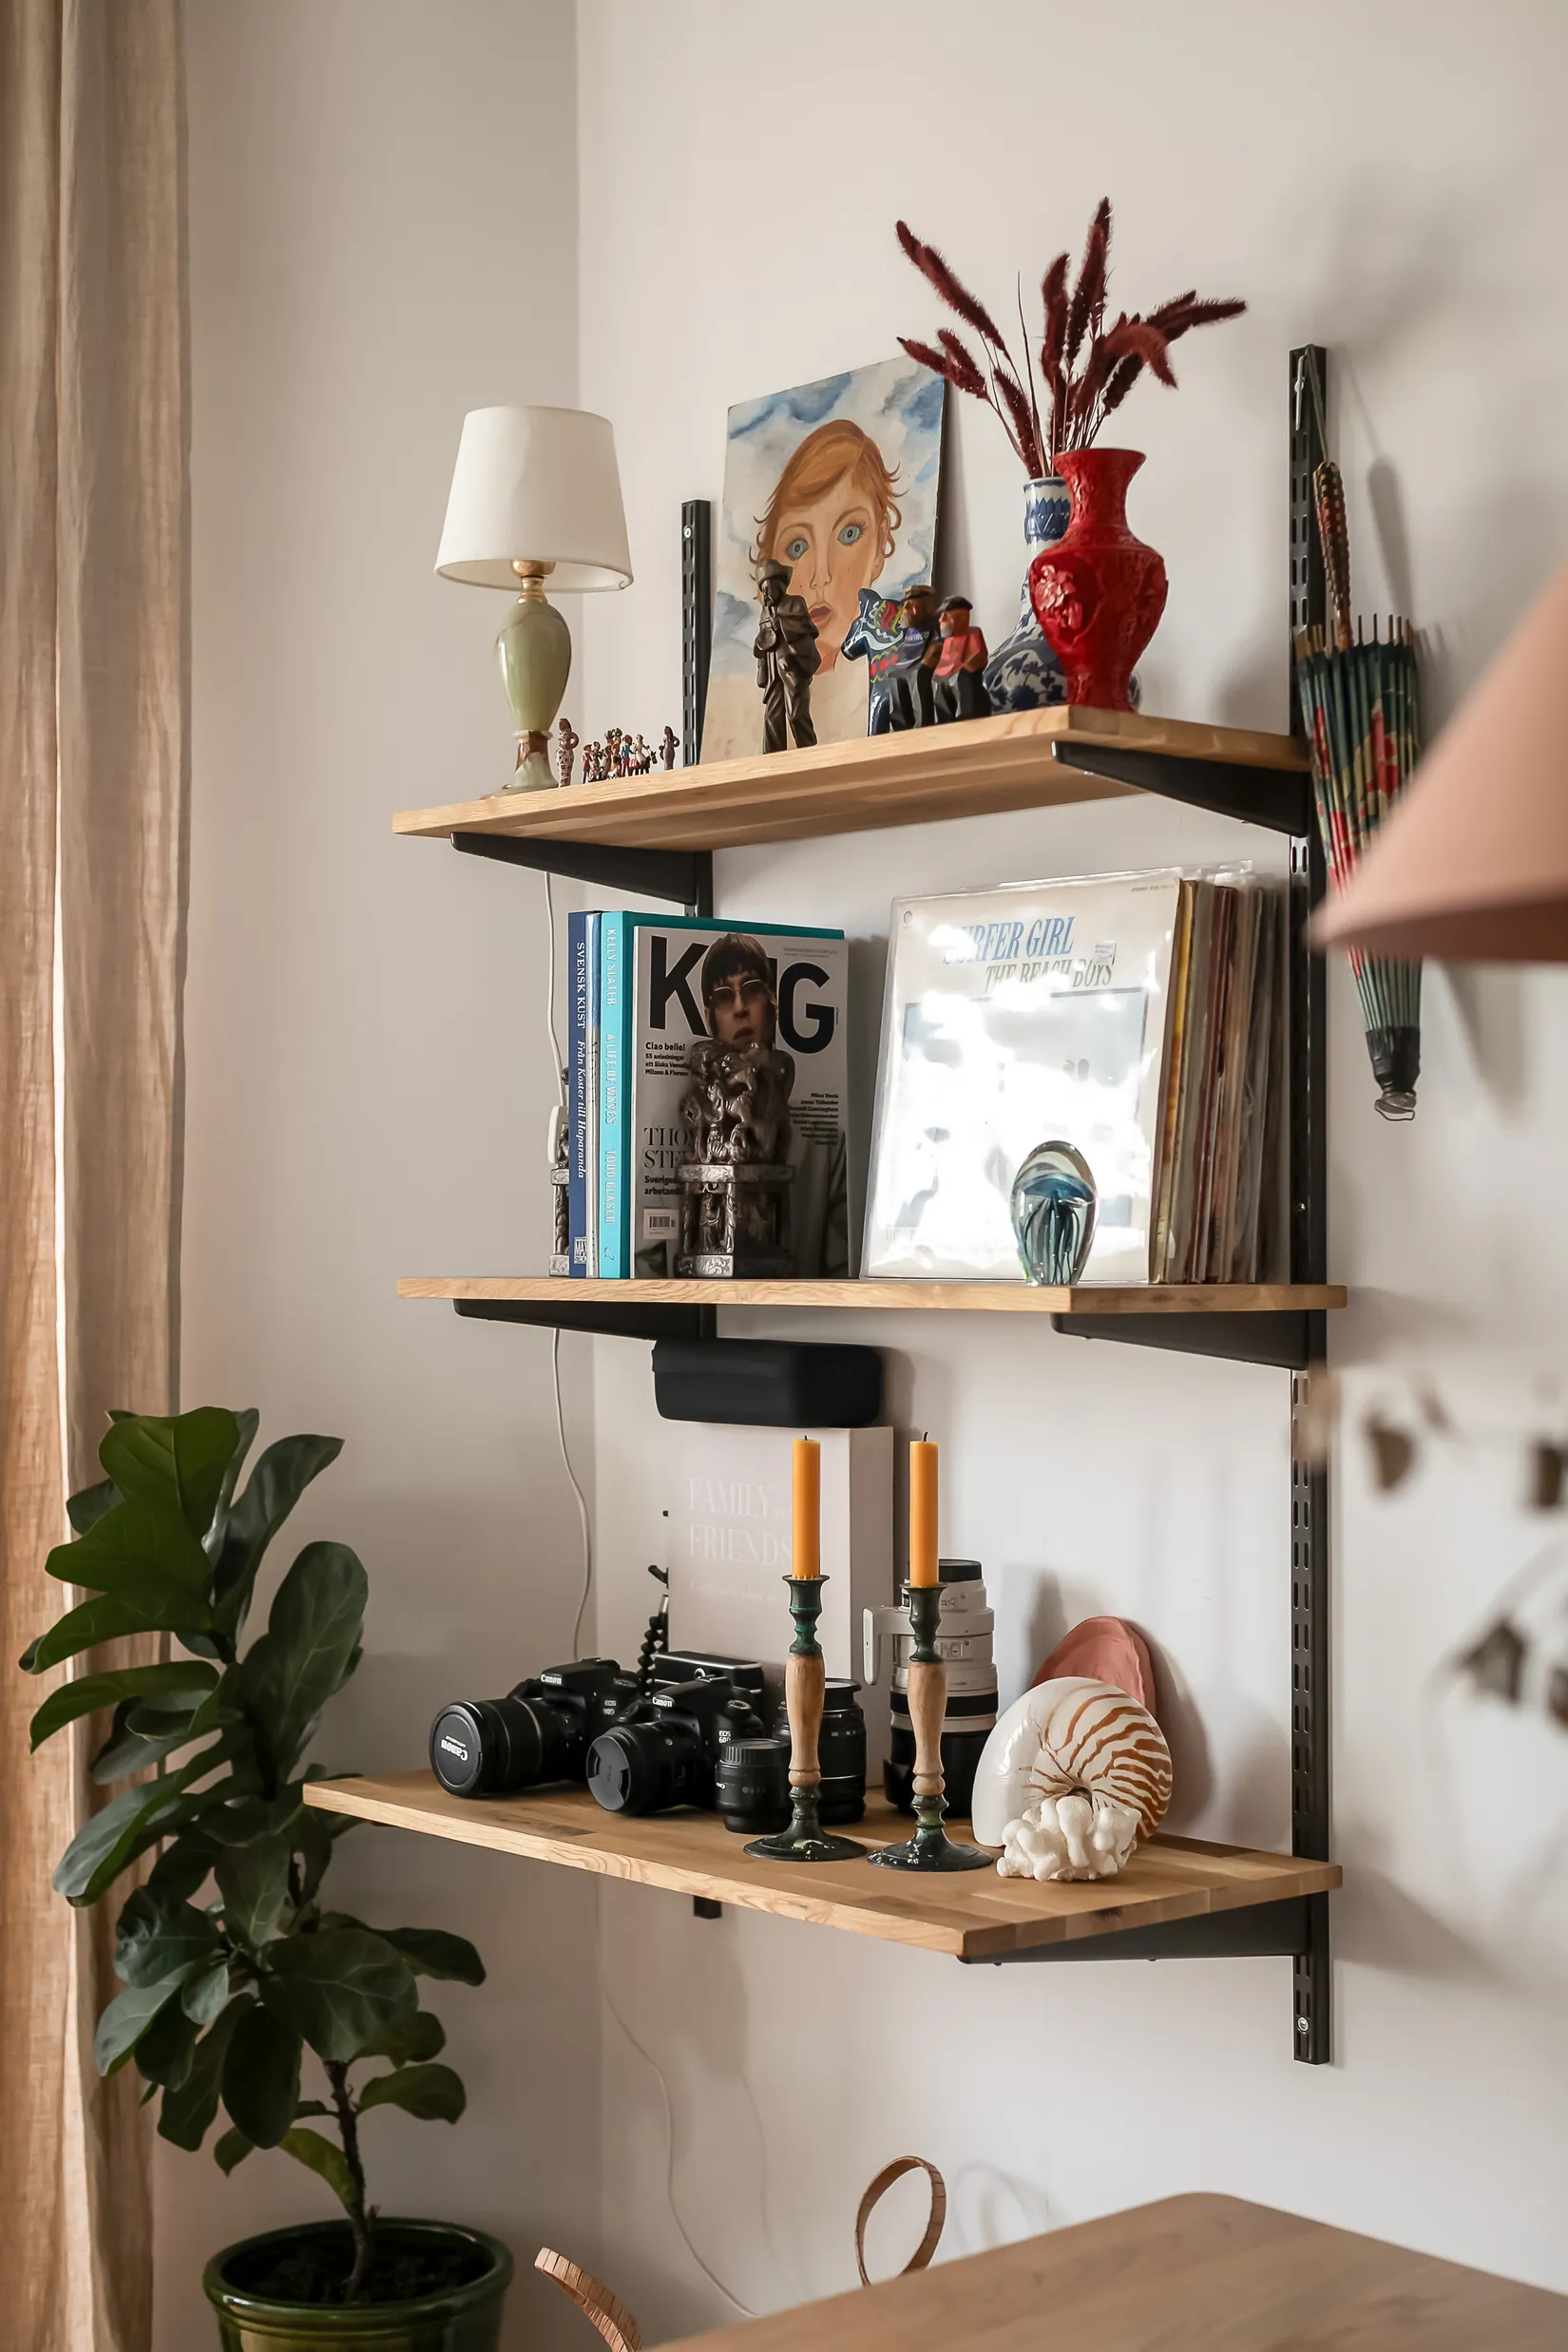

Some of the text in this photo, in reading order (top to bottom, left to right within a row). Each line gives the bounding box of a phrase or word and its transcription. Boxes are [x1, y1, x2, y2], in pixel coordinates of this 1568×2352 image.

[943, 921, 1024, 965] RFER
[1025, 916, 1076, 958] GIRL
[577, 942, 585, 1028] SVENSK KUST
[606, 928, 616, 1005] KELLY SLATER
[649, 935, 835, 1054] KG
[577, 1041, 585, 1064] Från
[606, 1044, 616, 1066] LIFE
[577, 1068, 585, 1100] Koster
[605, 1070, 616, 1082] OF
[605, 1086, 616, 1124] WAVES
[576, 1120, 586, 1178] Haparanda
[643, 1126, 692, 1147] THO
[605, 1149, 616, 1224] TODD GLASER
[689, 1476, 773, 1519] FAMILY
[689, 1522, 792, 1570] FRIENDS
[541, 1673, 562, 1685] Canon
[652, 1696, 673, 1707] Canon
[441, 1738, 468, 1762] Canon
